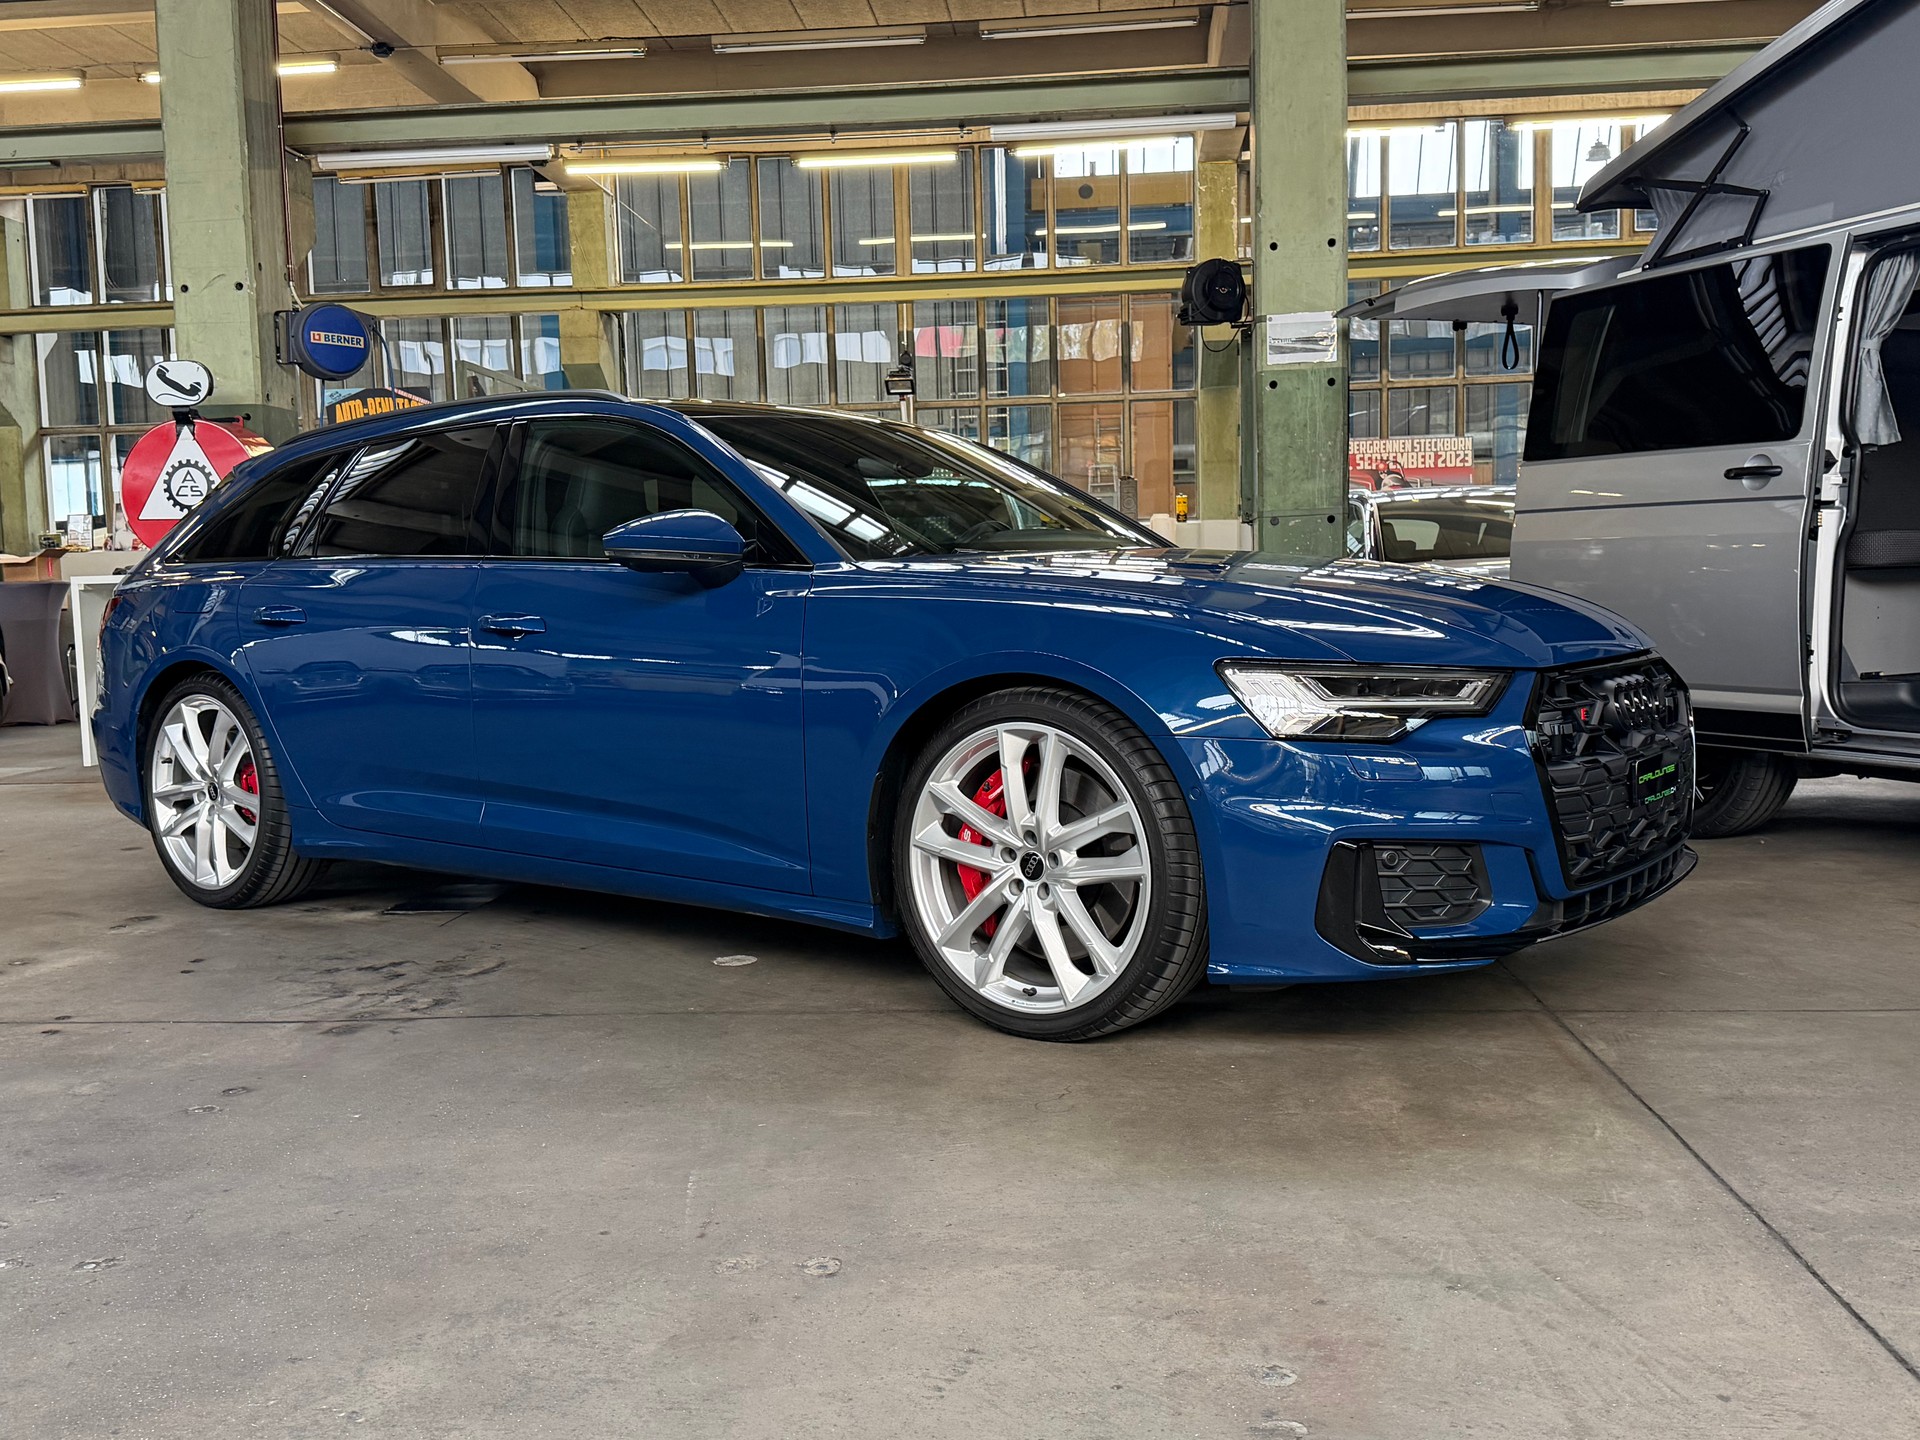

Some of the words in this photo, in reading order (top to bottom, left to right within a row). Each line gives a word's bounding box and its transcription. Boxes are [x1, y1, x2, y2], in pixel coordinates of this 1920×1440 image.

[324, 333, 362, 347] BERNER
[1414, 437, 1473, 451] STECKBORN
[1437, 449, 1473, 467] 2023
[1638, 763, 1676, 785] CARLOUNGE
